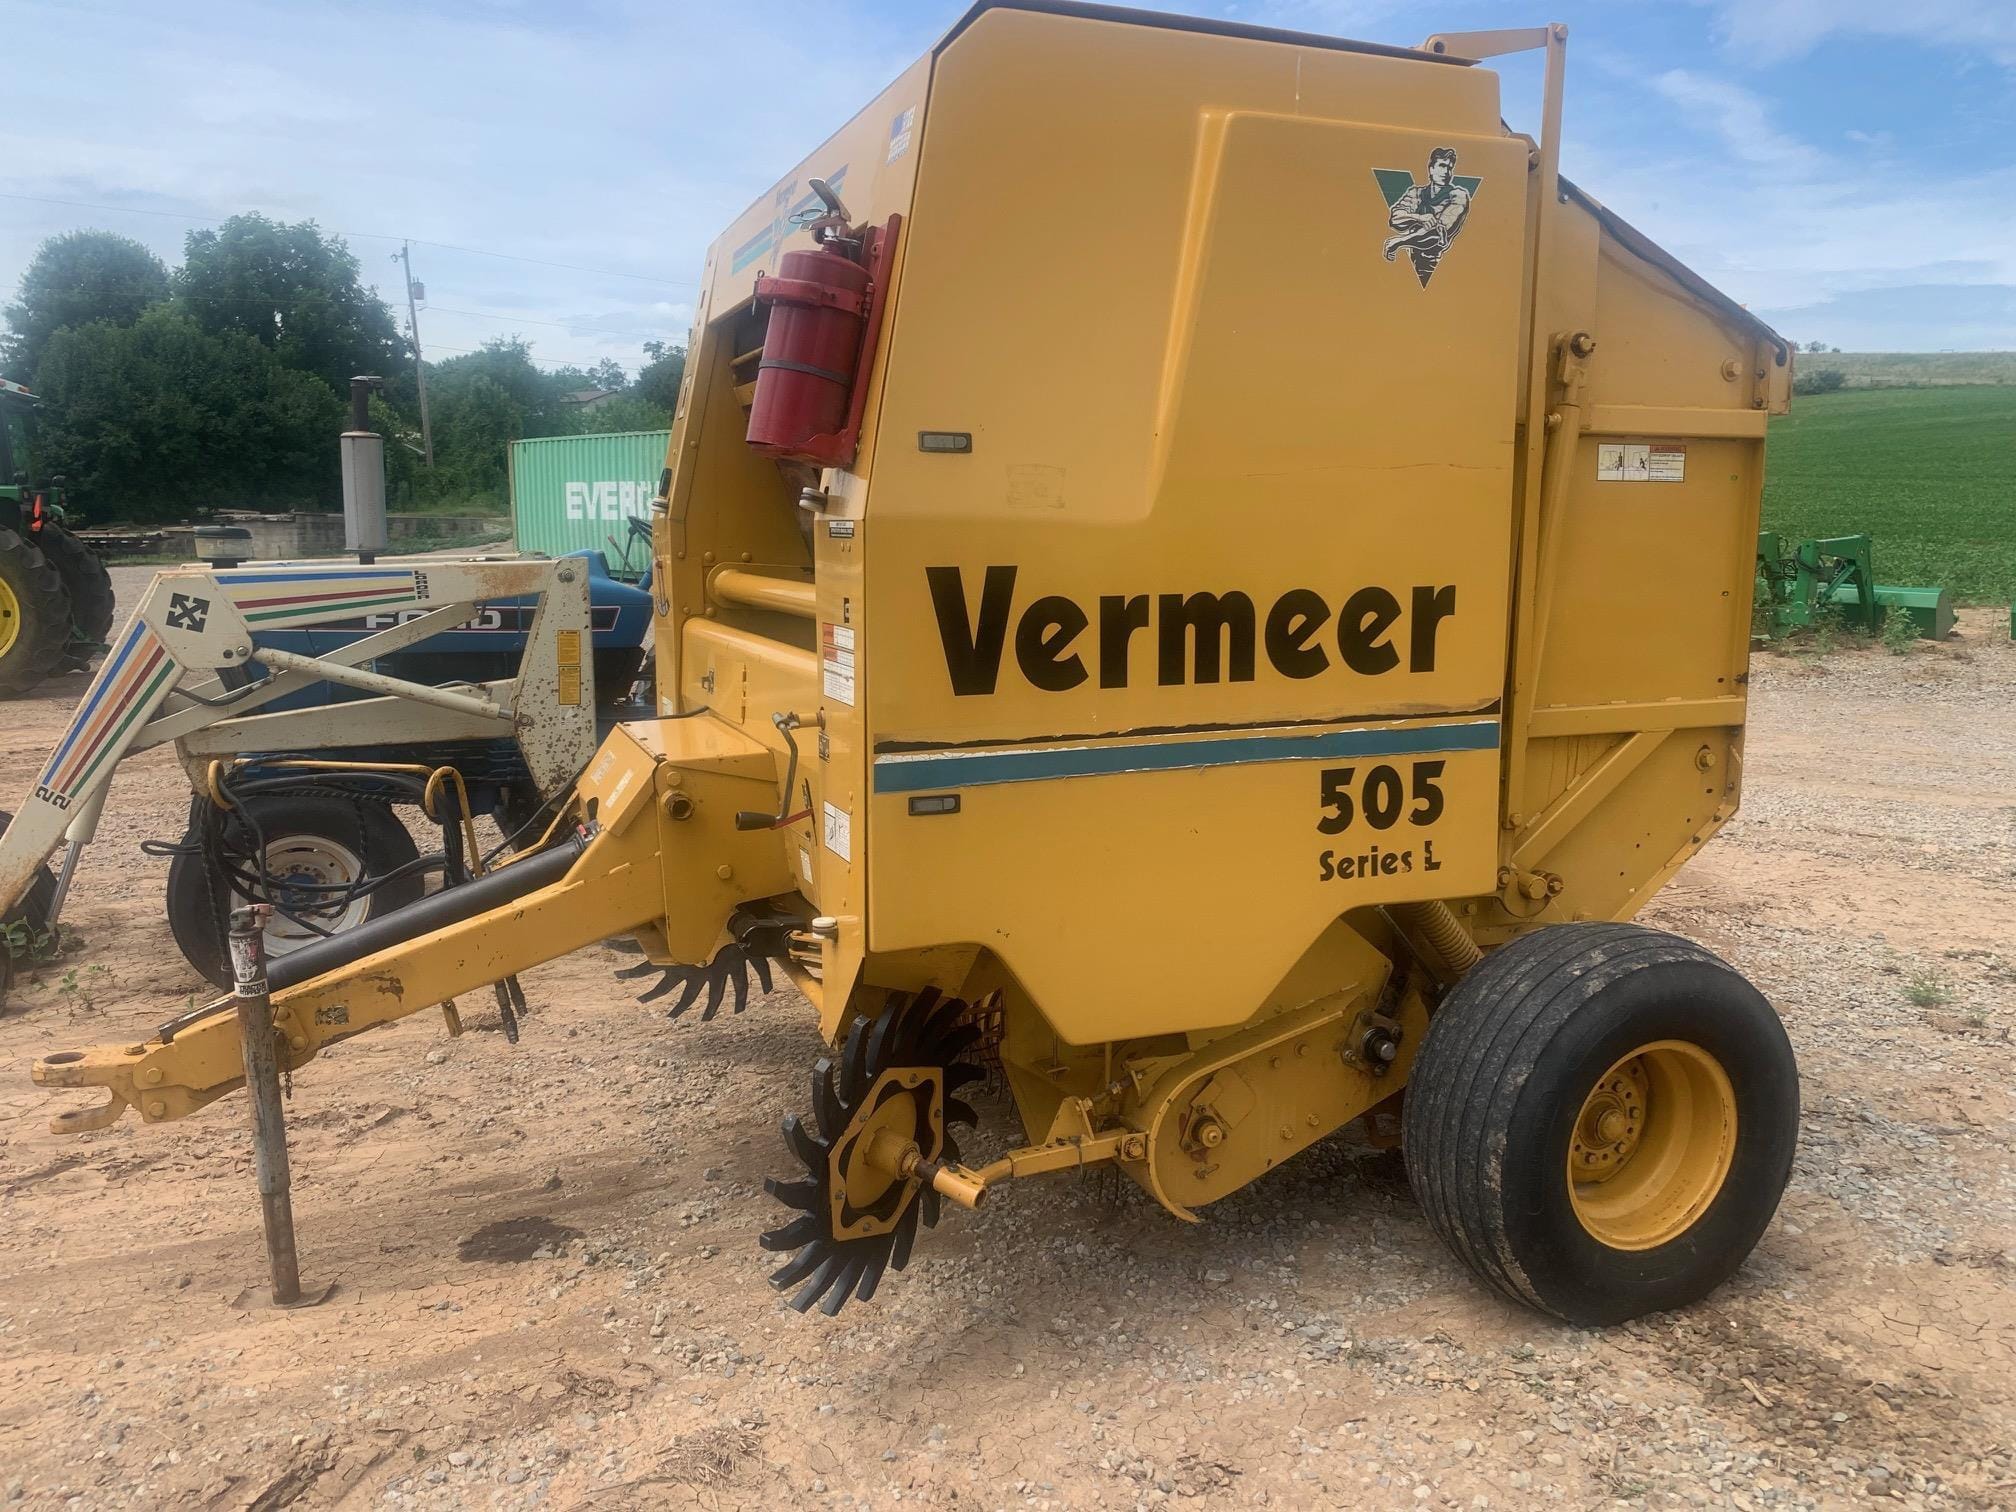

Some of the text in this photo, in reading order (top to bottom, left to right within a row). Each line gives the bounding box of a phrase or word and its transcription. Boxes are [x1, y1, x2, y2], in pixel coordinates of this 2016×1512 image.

[366, 609, 502, 630] FOD
[925, 565, 1456, 697] Vermeer
[35, 786, 72, 811] 22
[1316, 760, 1446, 835] 505
[1319, 840, 1441, 882] Series L
